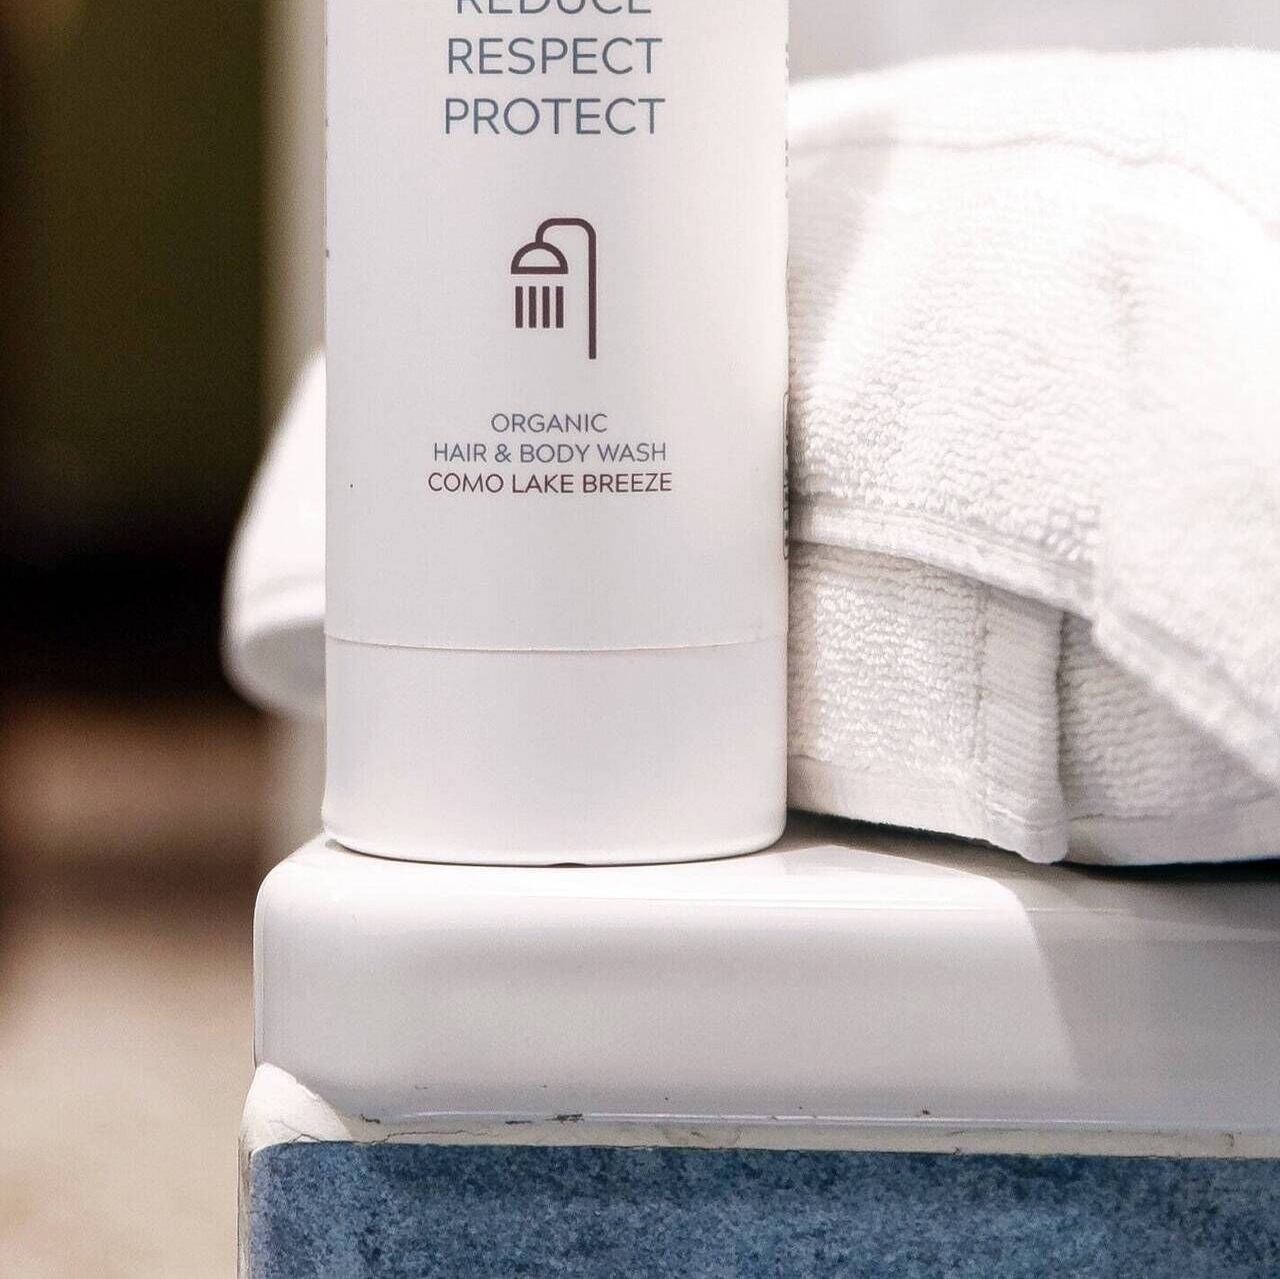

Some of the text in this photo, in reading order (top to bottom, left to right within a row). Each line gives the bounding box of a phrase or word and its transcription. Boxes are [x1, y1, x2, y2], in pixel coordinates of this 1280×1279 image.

[448, 37, 662, 74] RESPECT
[446, 98, 666, 135] PROTECT
[491, 412, 608, 434] ORGANIC
[434, 442, 666, 463] HAIR & BODY WASH
[428, 471, 672, 493] COMO LAKE BREEZE
